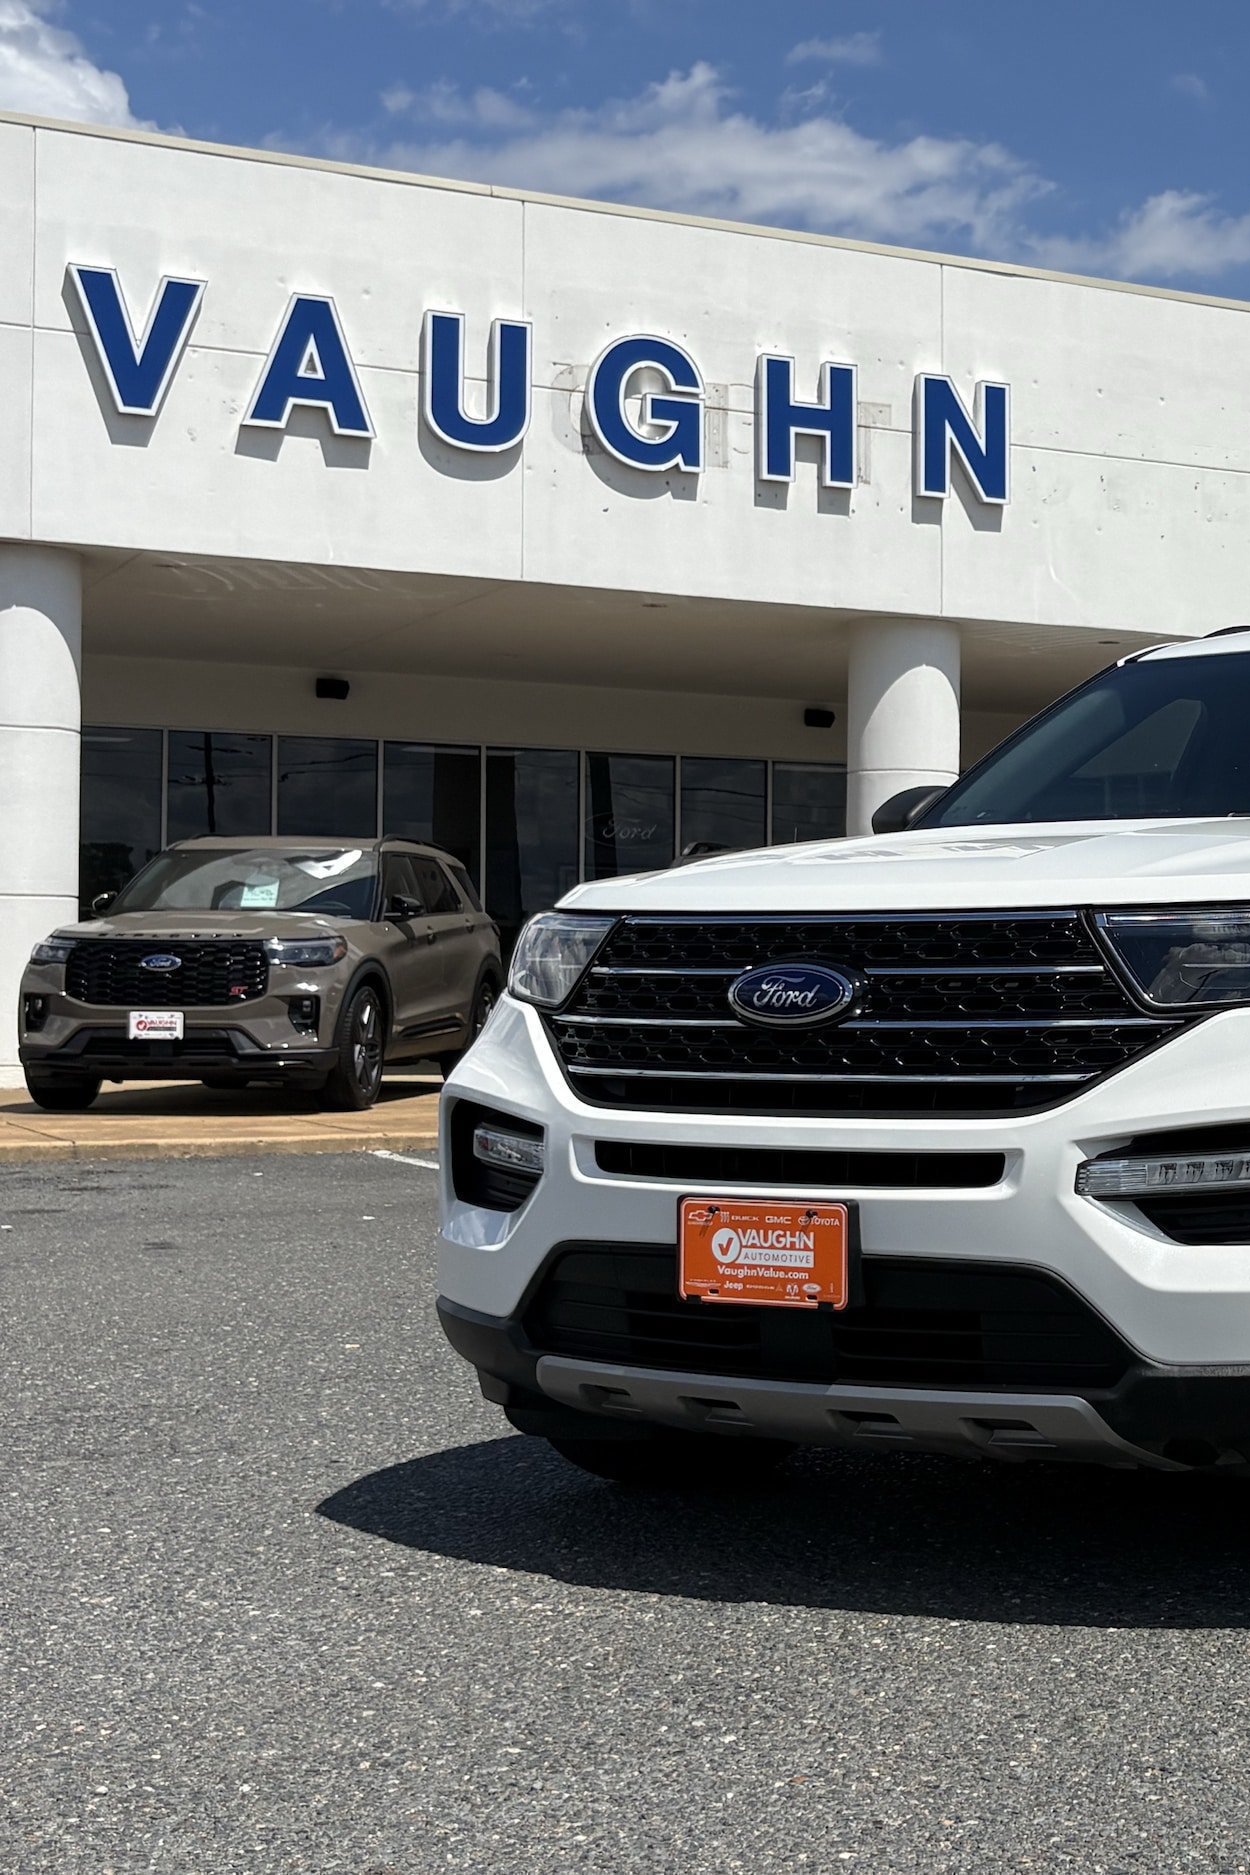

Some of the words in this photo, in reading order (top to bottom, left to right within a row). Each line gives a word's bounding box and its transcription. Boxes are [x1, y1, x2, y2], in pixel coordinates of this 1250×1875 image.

[66, 263, 1011, 505] VAUGHN
[602, 818, 658, 841] Ford
[149, 958, 172, 967] Ford
[229, 985, 249, 996] ST
[753, 975, 821, 1008] Ford
[766, 1216, 792, 1224] GMC
[810, 1216, 840, 1226] TOYOTA
[738, 1228, 814, 1250] VAUGHN
[743, 1251, 812, 1264] AUTOMOTIVE
[717, 1265, 809, 1280] VaughnValue.com
[724, 1281, 743, 1290] Jeep
